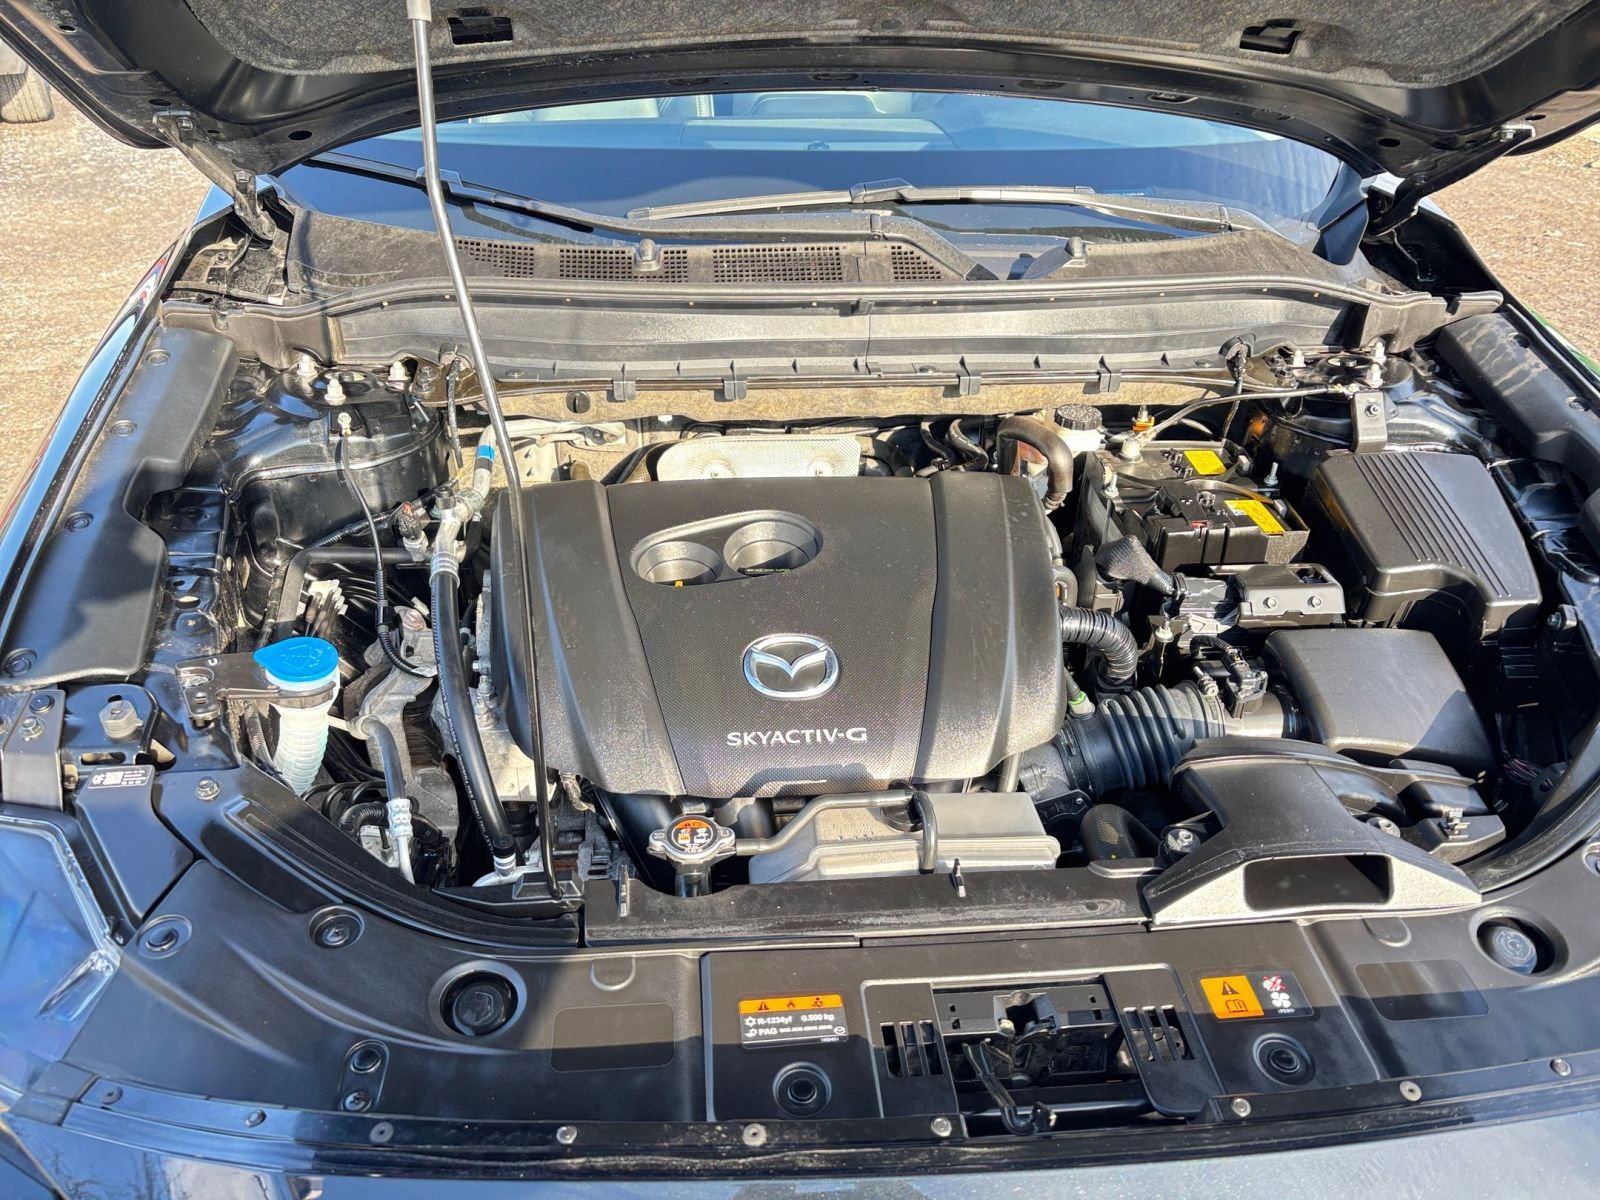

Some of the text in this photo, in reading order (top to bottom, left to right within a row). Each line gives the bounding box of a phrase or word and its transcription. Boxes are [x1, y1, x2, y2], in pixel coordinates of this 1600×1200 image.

[726, 727, 868, 747] SKYACTIV-G
[757, 1013, 835, 1025] R-1234yf 0.500 kg
[759, 1028, 778, 1036] PAG
